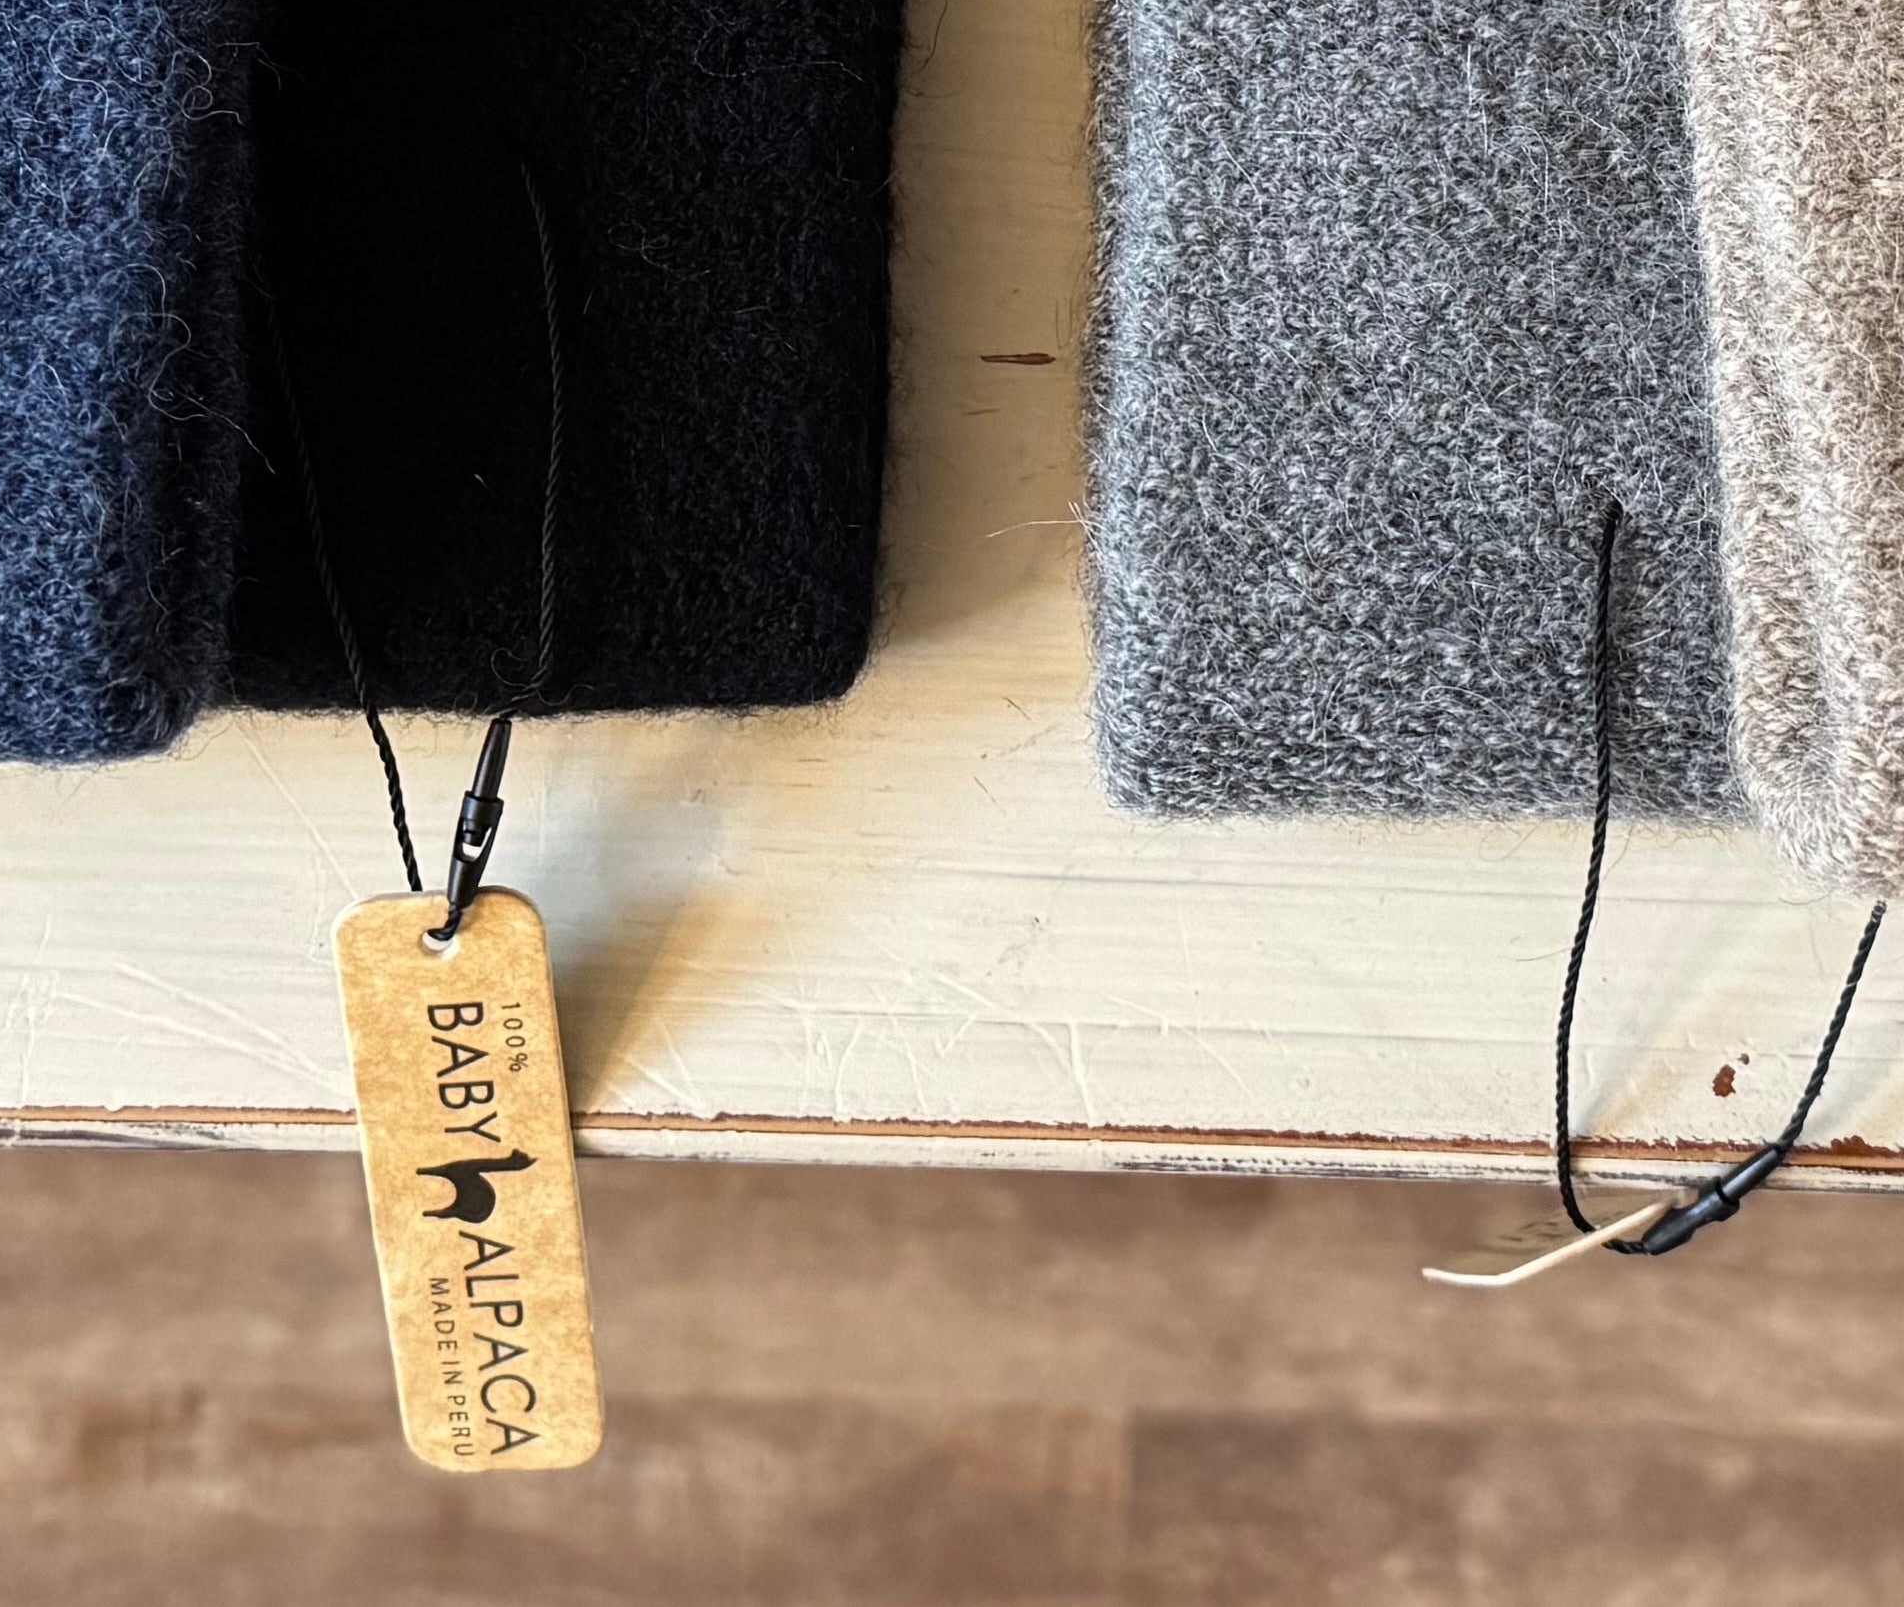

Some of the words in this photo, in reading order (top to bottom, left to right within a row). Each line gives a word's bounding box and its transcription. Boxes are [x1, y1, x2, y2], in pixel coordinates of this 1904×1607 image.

[427, 1001, 501, 1144] BABY
[501, 1001, 529, 1073] 100%
[428, 1277, 458, 1353] MADE
[458, 1229, 541, 1456] ALPACA
[440, 1360, 464, 1385] IN
[447, 1394, 476, 1457] PERU
